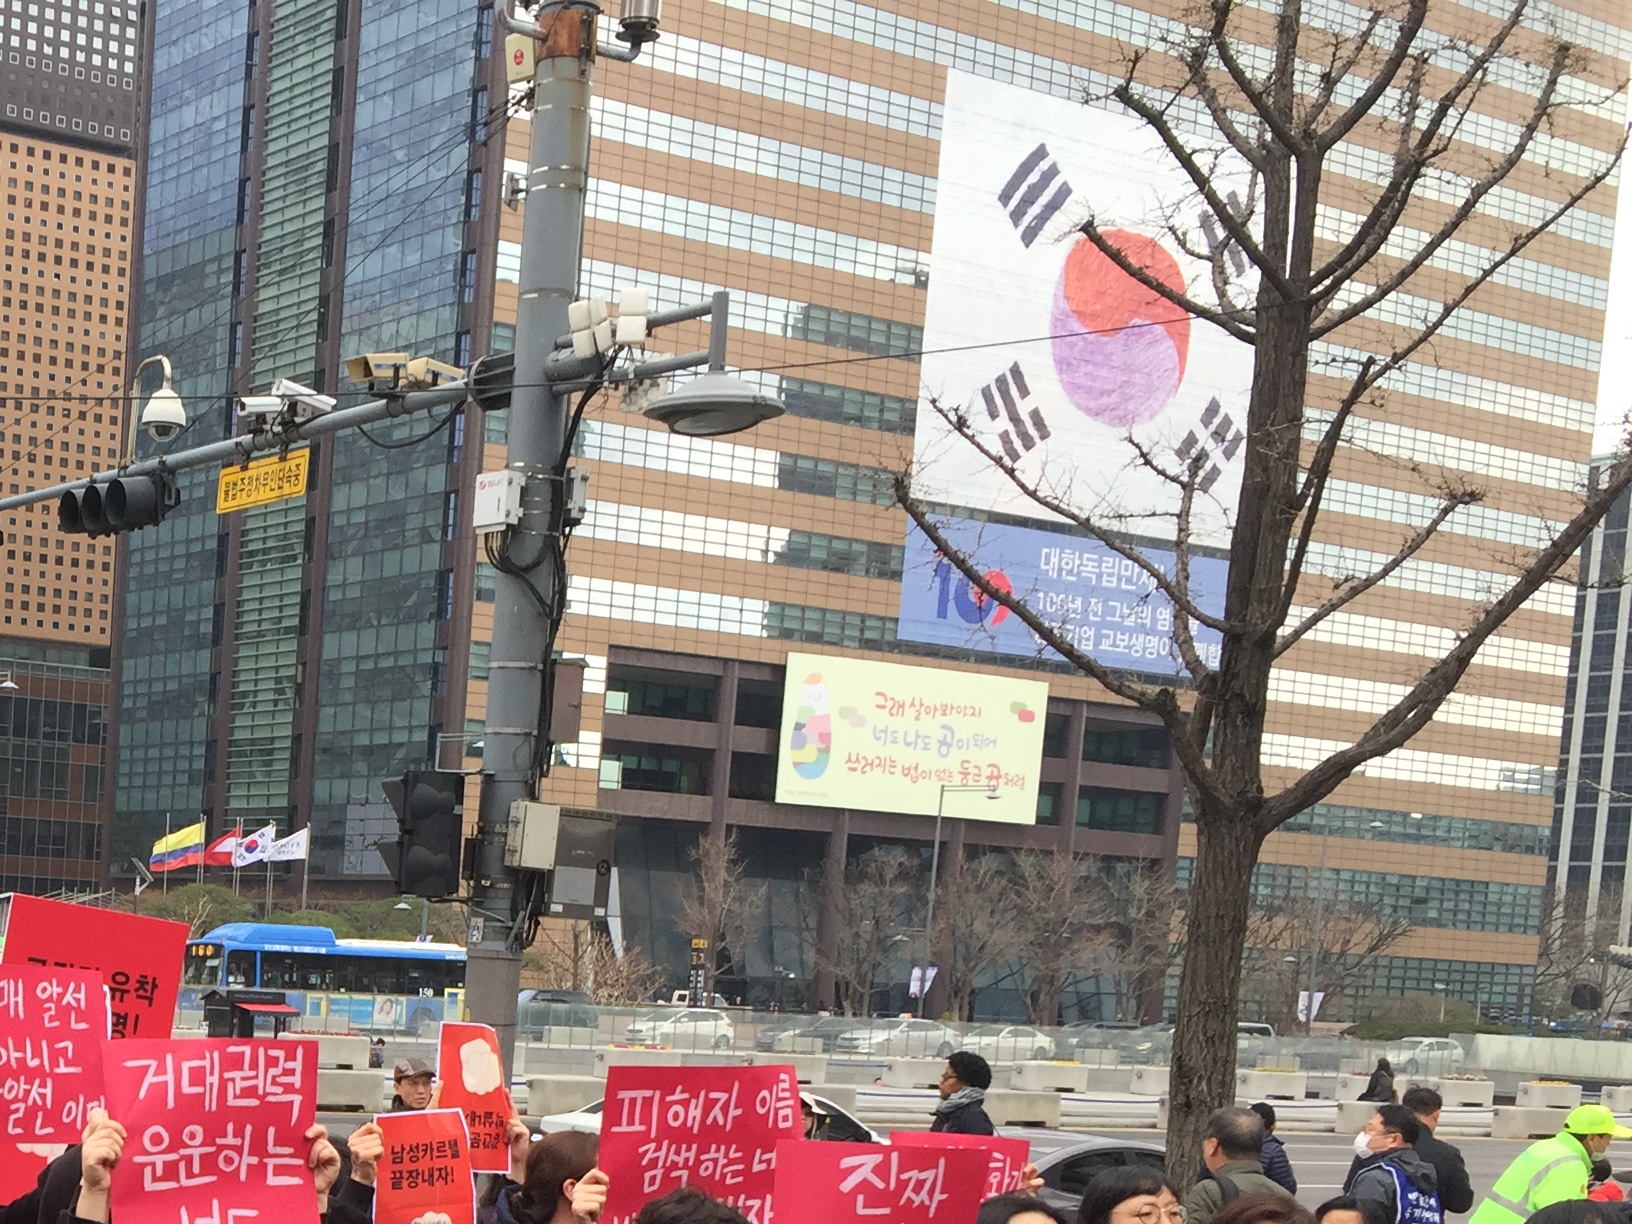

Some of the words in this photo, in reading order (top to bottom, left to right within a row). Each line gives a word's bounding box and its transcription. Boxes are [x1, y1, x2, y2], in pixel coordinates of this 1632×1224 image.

[1088, 597, 1103, 622] 전
[875, 691, 905, 718] 그래
[909, 696, 982, 721] 살아봐야지
[873, 725, 900, 747] 너도
[903, 729, 932, 751] 나도
[937, 724, 970, 758] 공이
[845, 751, 897, 775] 쓰러지는
[901, 765, 932, 784] 법이
[958, 759, 982, 786] 둥근
[35, 977, 90, 1031] 알선
[122, 1045, 304, 1126] 거대권력
[610, 1080, 744, 1138] 피해자
[755, 1072, 795, 1129] 이름
[131, 1122, 305, 1192] 운운하는
[390, 1138, 460, 1165] 남성카르텔
[388, 1165, 455, 1189] 끝장내자!
[838, 1151, 949, 1218] 진짜
